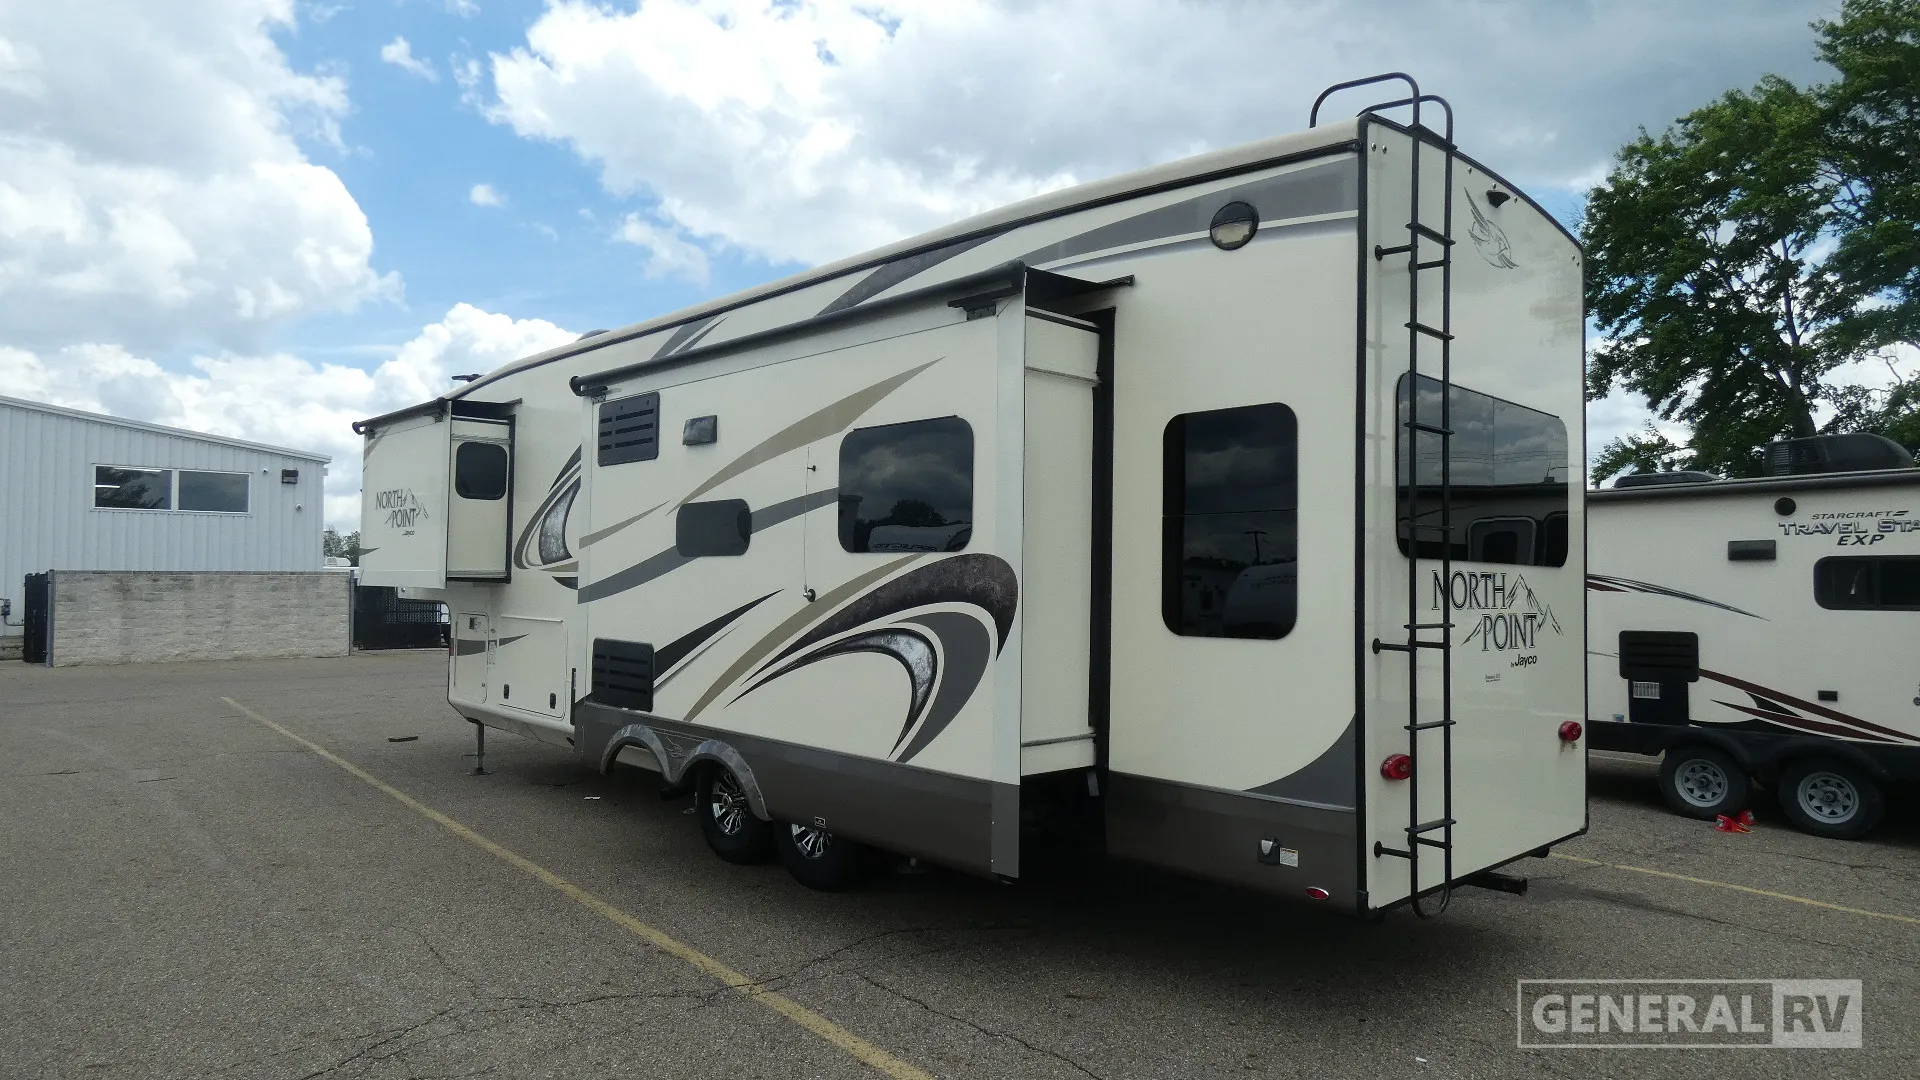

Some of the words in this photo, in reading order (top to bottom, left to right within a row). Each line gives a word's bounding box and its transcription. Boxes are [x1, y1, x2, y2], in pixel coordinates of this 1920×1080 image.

[376, 489, 403, 510] NORTH
[391, 508, 416, 528] POINT
[1812, 510, 1893, 520] STARCRAFT
[1778, 521, 1868, 536] TRAVEL
[1836, 534, 1885, 546] EXP
[1431, 569, 1507, 611] NORTH
[1481, 612, 1538, 652] POINT
[1514, 653, 1538, 668] Jayco
